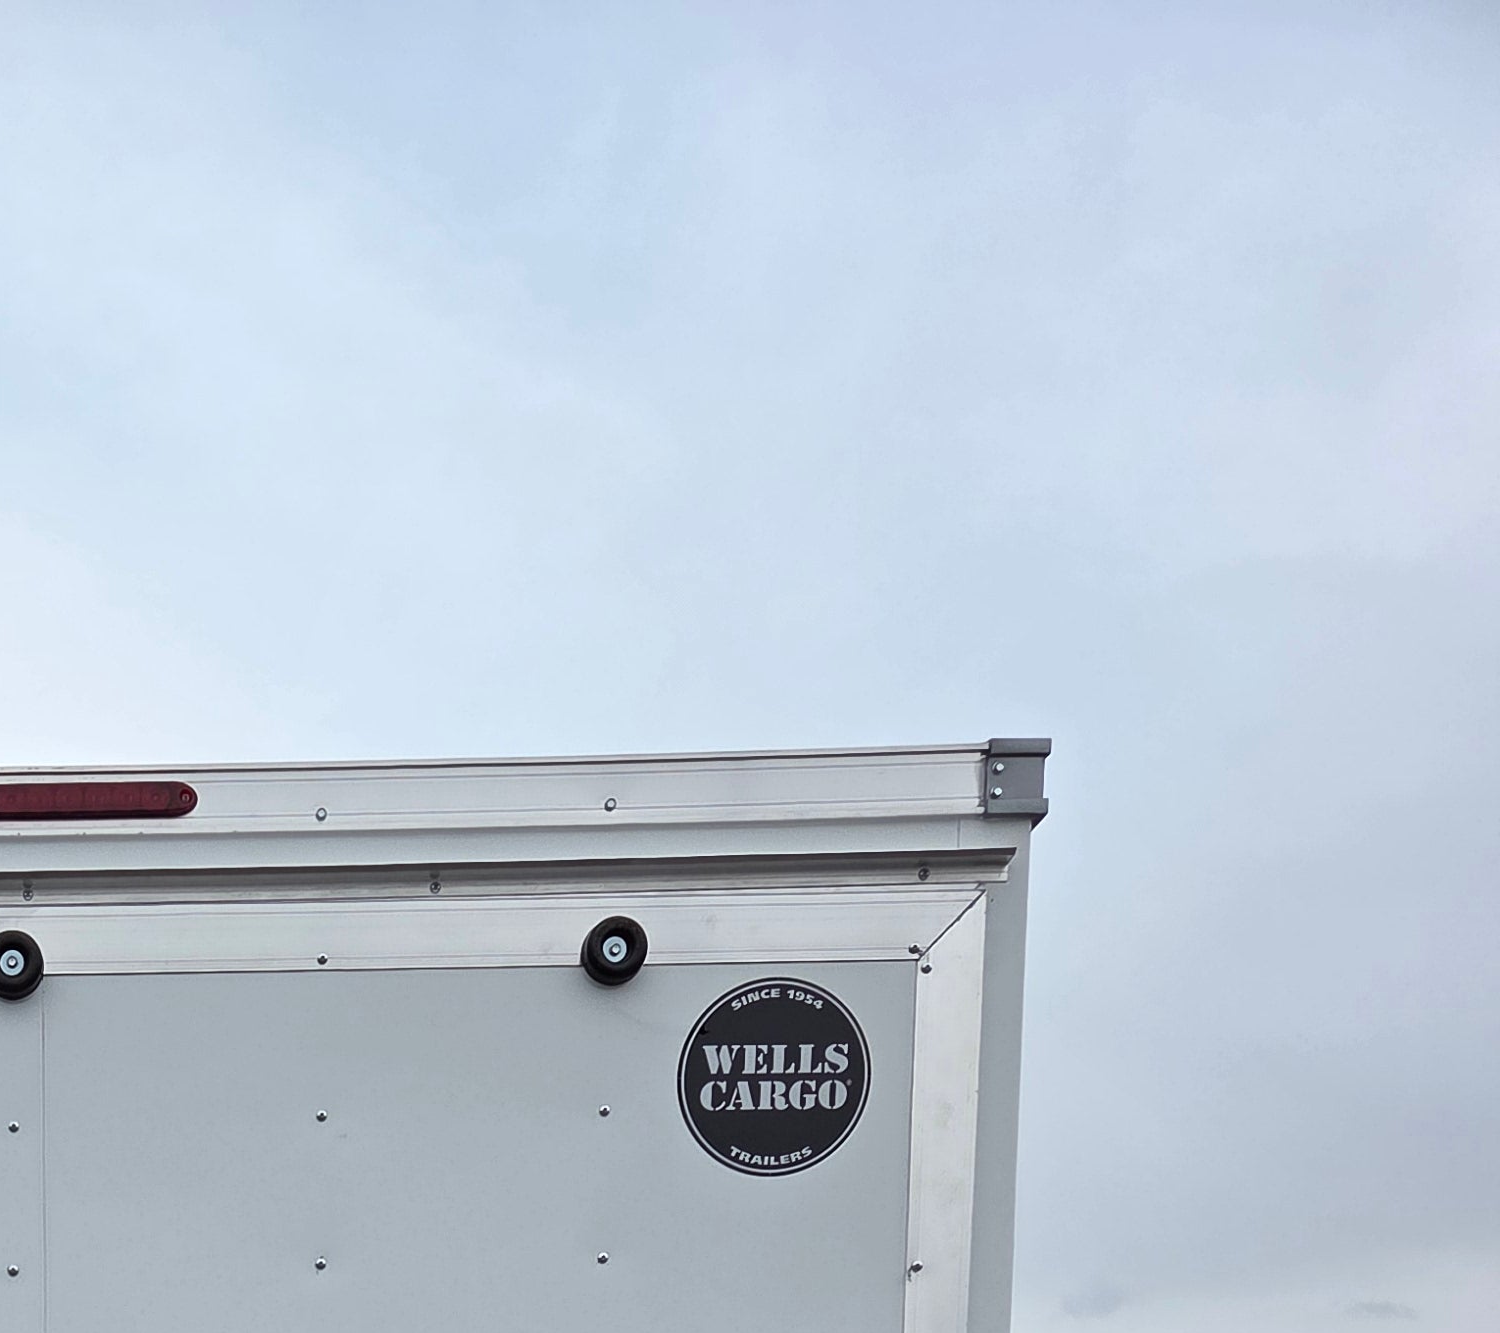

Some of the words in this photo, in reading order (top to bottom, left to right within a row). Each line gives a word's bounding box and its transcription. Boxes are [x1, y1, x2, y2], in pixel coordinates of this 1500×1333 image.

[731, 988, 781, 1011] SINCE
[786, 989, 824, 1010] 1954
[702, 1043, 849, 1075] WELLS
[699, 1079, 848, 1111] CARGO
[729, 1146, 813, 1166] TRAILERS
